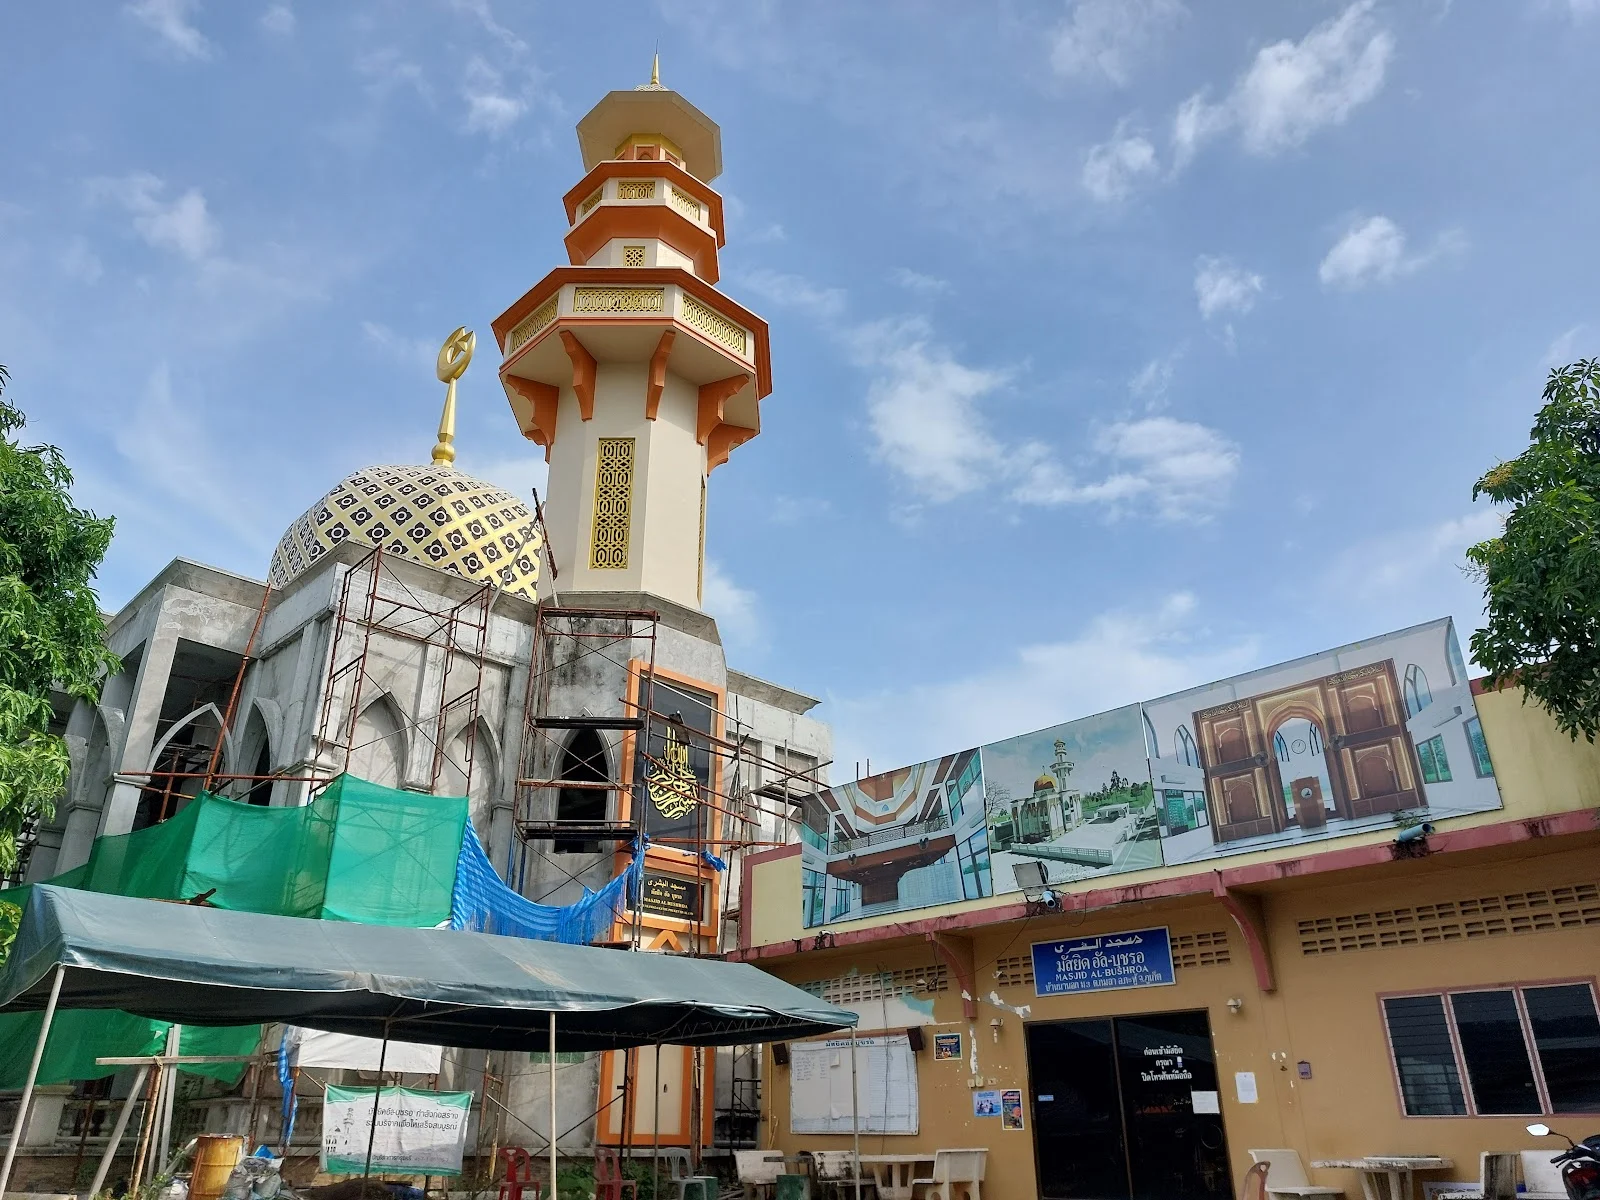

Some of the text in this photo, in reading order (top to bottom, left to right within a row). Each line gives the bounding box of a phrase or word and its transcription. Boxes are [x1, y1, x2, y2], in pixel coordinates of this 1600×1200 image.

[1054, 935, 1143, 954] مسجد البشرى
[1056, 951, 1145, 973] มัสยิด อัล-บุชรอ
[1055, 965, 1149, 982] MASJID AL-BUSHROA
[1156, 1059, 1173, 1070] กรุณา
